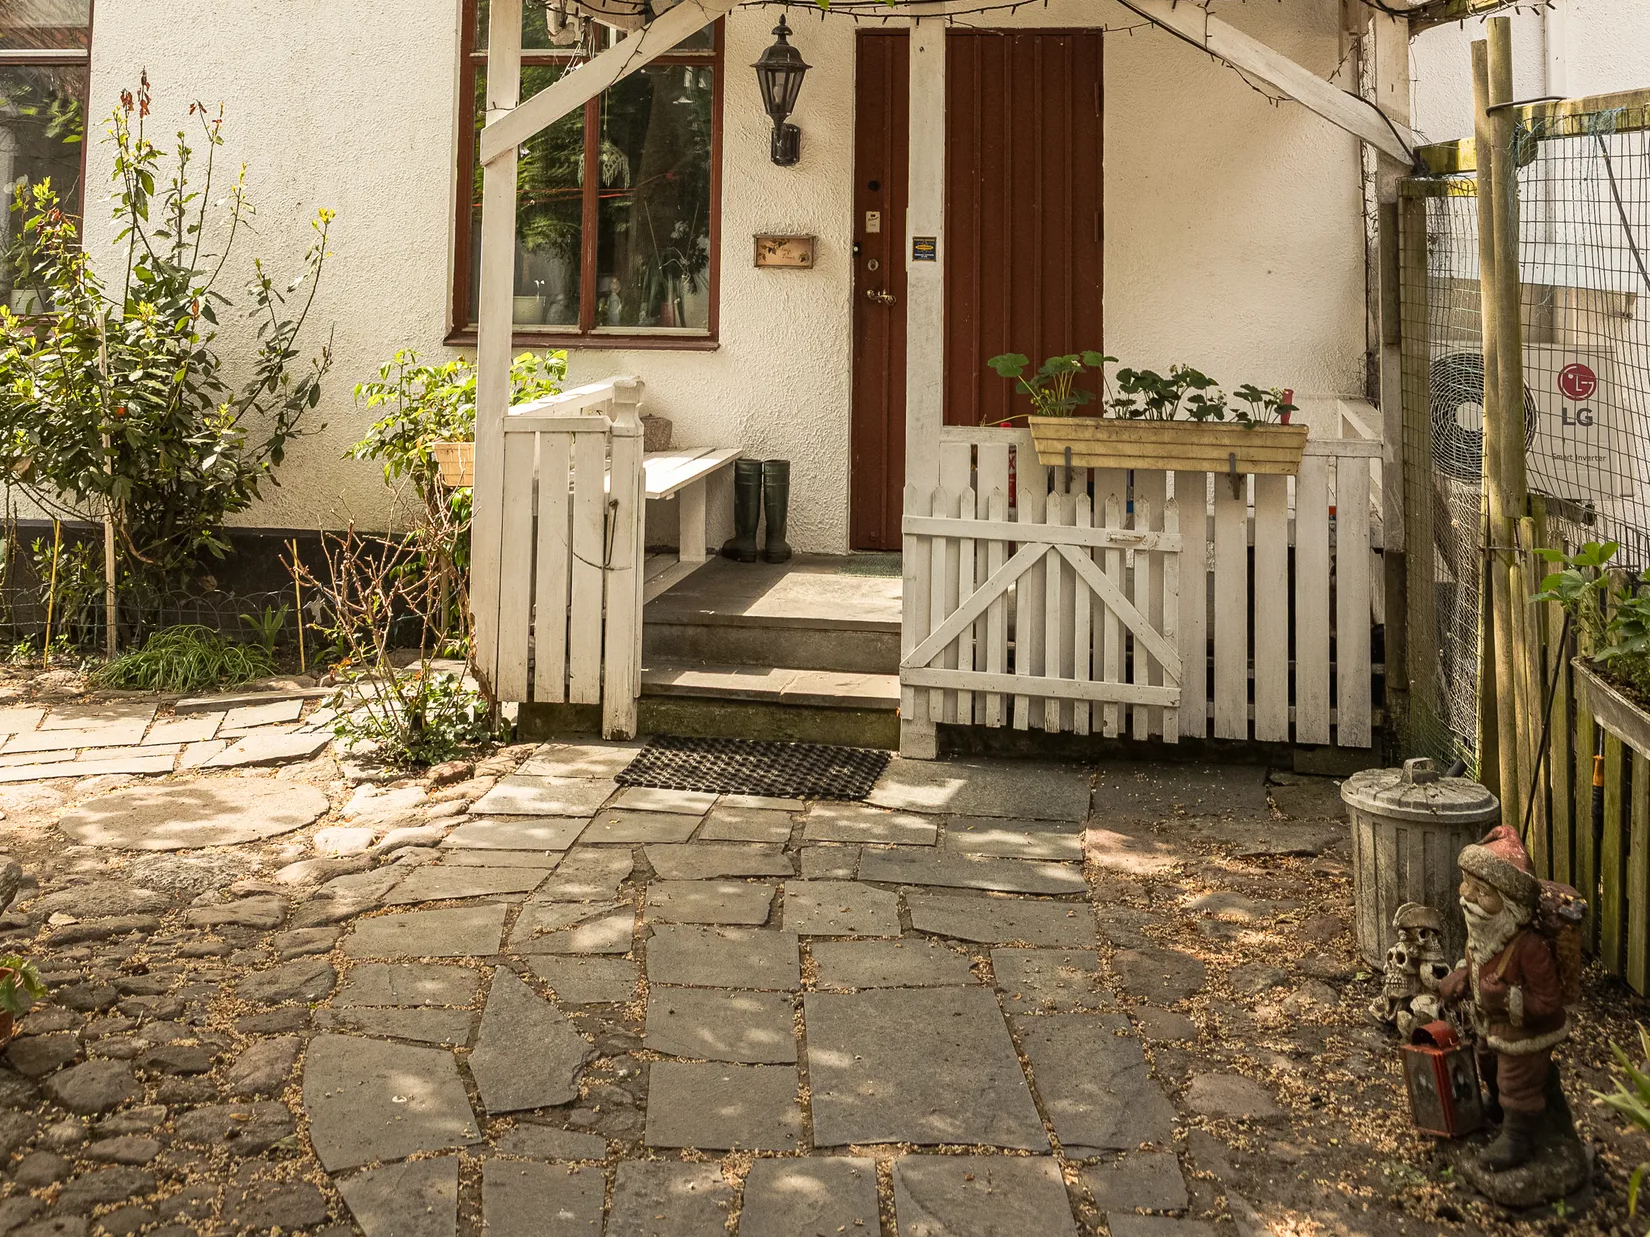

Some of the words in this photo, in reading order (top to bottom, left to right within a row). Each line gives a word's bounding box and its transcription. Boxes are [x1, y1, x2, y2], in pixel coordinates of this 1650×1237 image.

[1562, 407, 1593, 427] LG
[1552, 452, 1573, 461] Smart
[1575, 453, 1607, 462] Inverter
